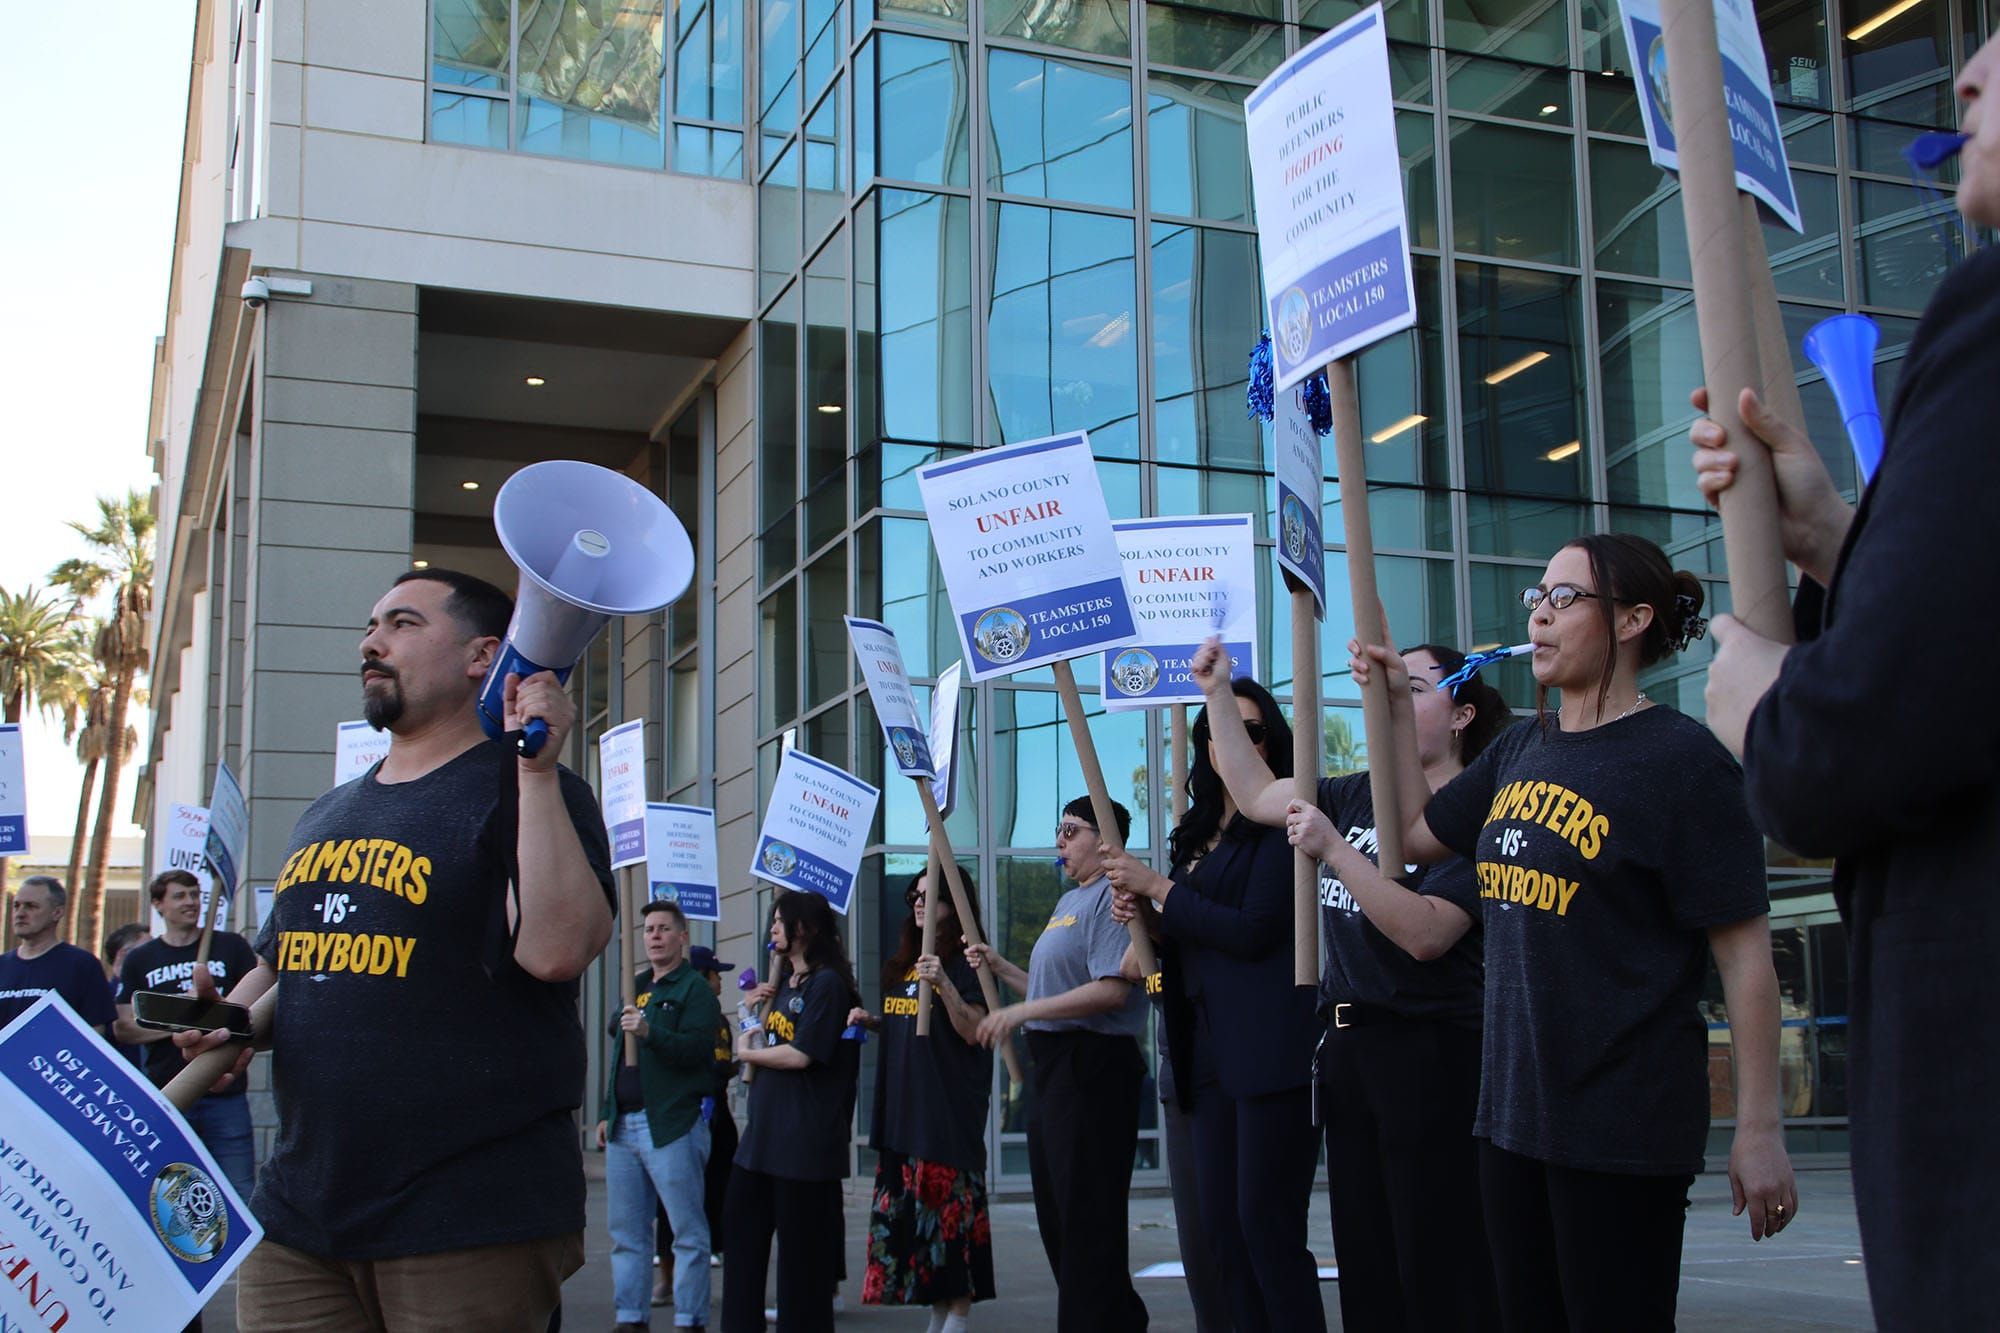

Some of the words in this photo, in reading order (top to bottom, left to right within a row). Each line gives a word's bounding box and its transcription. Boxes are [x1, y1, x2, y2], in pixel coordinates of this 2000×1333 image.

[1790, 56, 1817, 69] SEIU
[1285, 90, 1327, 129] PUBLIC
[1279, 107, 1345, 161] DEFENDERS
[1284, 135, 1344, 186] FIGHTING
[1291, 189, 1313, 210] FOR
[1316, 168, 1341, 195] THE
[1285, 189, 1356, 244] COMMUNITY
[1311, 256, 1389, 310] TEAMSTERS
[1318, 297, 1363, 329] LOCAL
[1364, 285, 1385, 307] 150
[948, 486, 1010, 511] SOLANO
[1012, 472, 1072, 495] COUNTY
[976, 499, 1063, 534] UNFAIR
[967, 546, 989, 562] TO
[992, 524, 1084, 556] COMMUNITY
[978, 561, 1009, 579] AND
[1012, 544, 1085, 568] WORKERS
[1120, 549, 1172, 560] SOLANO
[1175, 546, 1230, 558] COUNTY
[1139, 566, 1216, 584] UNFAIR
[1029, 596, 1113, 625] TEAMSTERS
[1138, 610, 1156, 620] ND
[1160, 607, 1226, 619] WORKERS
[1146, 591, 1230, 605] COMMUNITY
[1040, 620, 1090, 640] LOCAL
[1091, 613, 1111, 628] 150
[793, 772, 830, 792] SOLANO
[830, 787, 863, 808] COUNTY
[802, 790, 849, 821] UNFAIR
[787, 816, 806, 828] AND
[808, 824, 848, 848] WORKERS
[788, 804, 801, 814] TO
[802, 809, 854, 838] COMMUNITY
[170, 848, 210, 874] UNFA
[668, 840, 700, 850] FIGHTING
[274, 838, 432, 905] EAMSTERS
[799, 859, 844, 886] TEAMSTERS
[799, 870, 826, 889] LOCAL
[826, 884, 838, 895] 150
[1477, 862, 1581, 917] ERYBODY
[278, 931, 417, 978] VERYBODY
[145, 960, 226, 988] TEAMSRS
[55, 1049, 93, 1081] 150
[28, 1054, 152, 1179] TEAMSTERS
[94, 1078, 162, 1152] LOCAL
[0, 1138, 90, 1242] WORKER
[0, 1176, 89, 1285] COMMU
[0, 1231, 70, 1333] UNF
[92, 1242, 135, 1291] AND
[88, 1287, 117, 1327] TO
